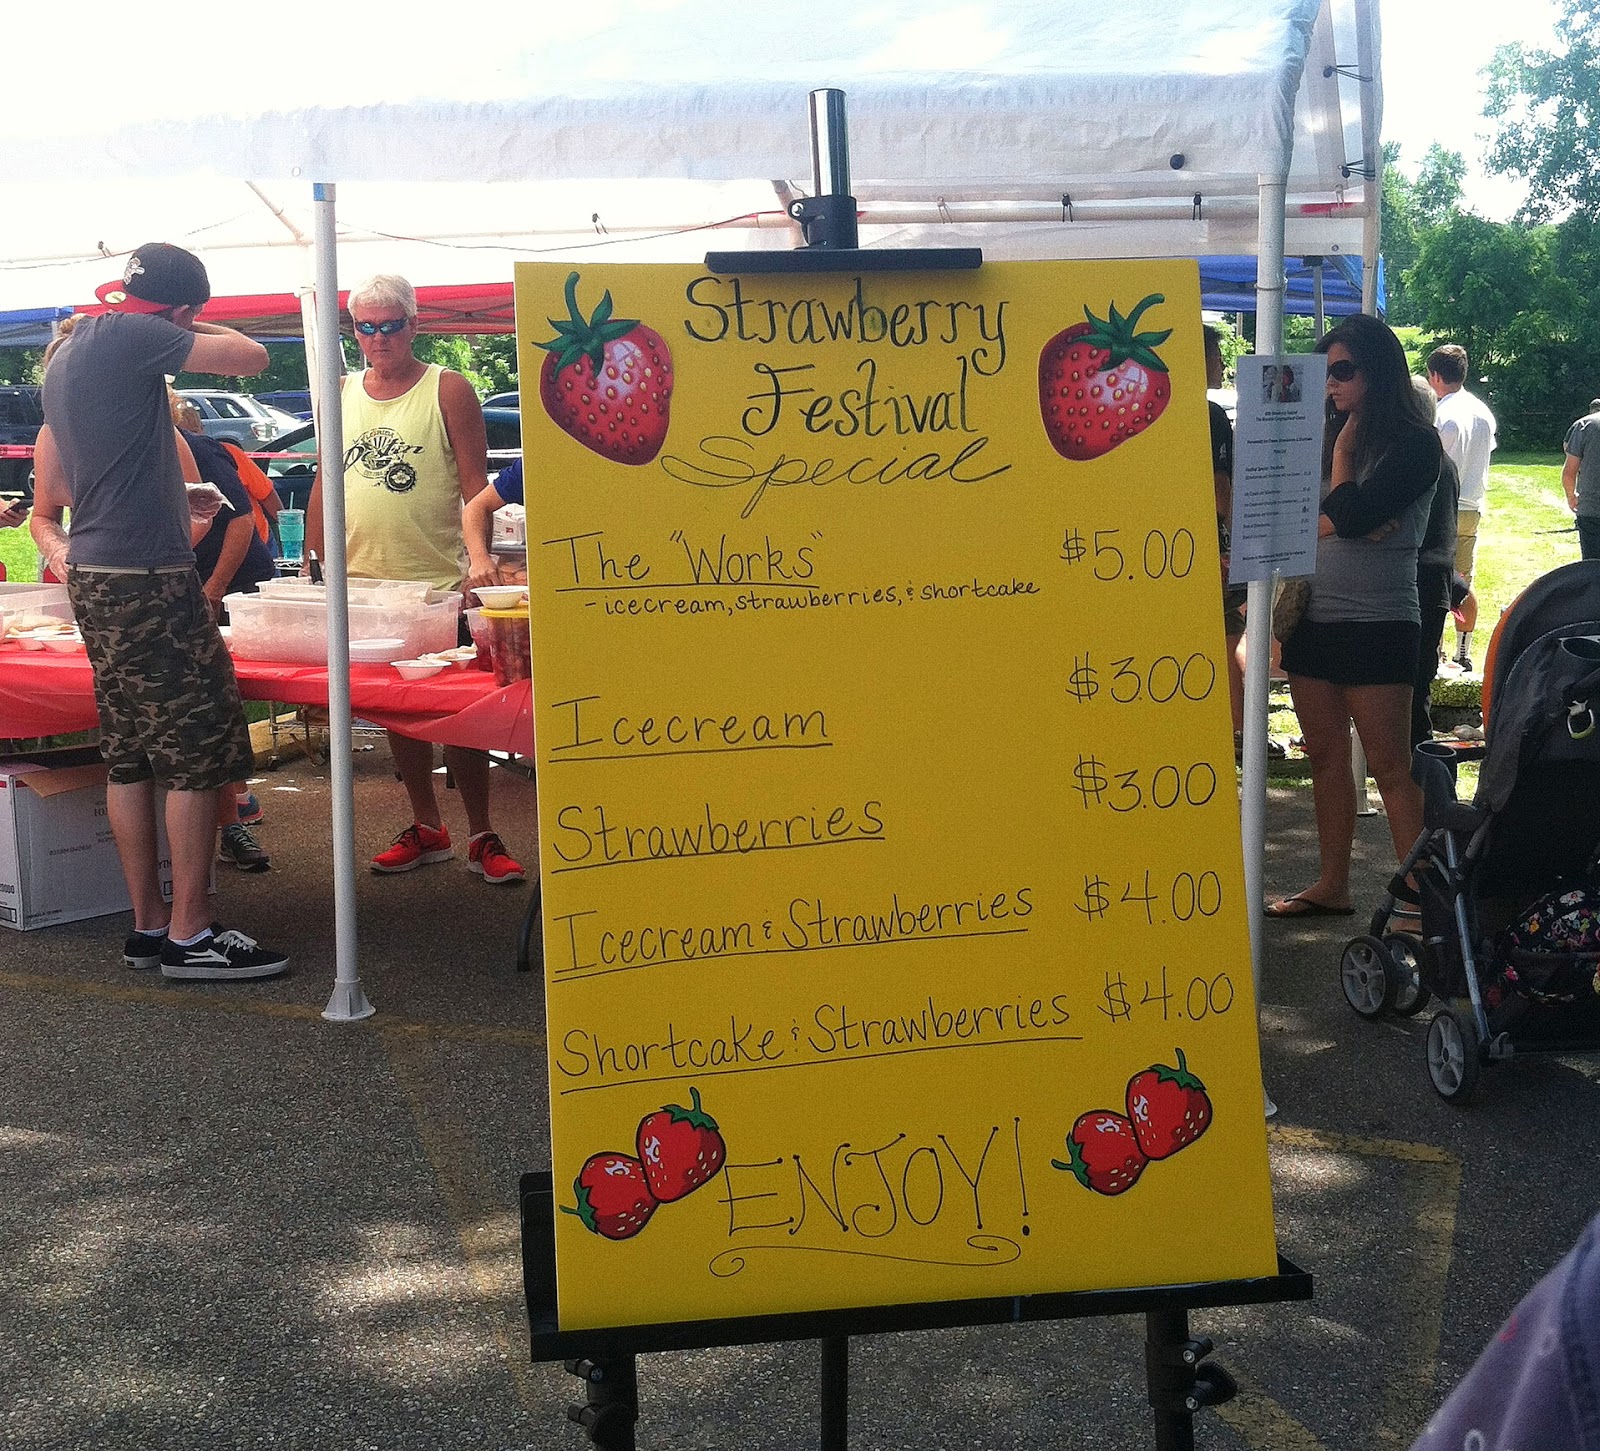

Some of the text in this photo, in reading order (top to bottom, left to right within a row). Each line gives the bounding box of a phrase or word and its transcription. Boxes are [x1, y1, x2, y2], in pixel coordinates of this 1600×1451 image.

[683, 276, 1010, 377] Strawberry
[741, 355, 979, 437] Festival
[660, 436, 1013, 520] Special
[542, 529, 824, 585] The "Works"
[1060, 527, 1195, 582] $5.00
[919, 577, 1041, 601] shortcake
[1066, 651, 1216, 704] $3.00
[551, 695, 830, 751] Icecream
[1072, 754, 1217, 812] $3.00
[552, 800, 886, 863] Strawberries
[1074, 869, 1222, 925] $4.00
[552, 909, 756, 974] Icecream
[781, 887, 1034, 950] Strawberries
[1097, 965, 1234, 1024] $4.00
[556, 1015, 785, 1077] Shortcake
[807, 994, 1071, 1053] Strawberries
[717, 1116, 1031, 1238] ENJOY!
